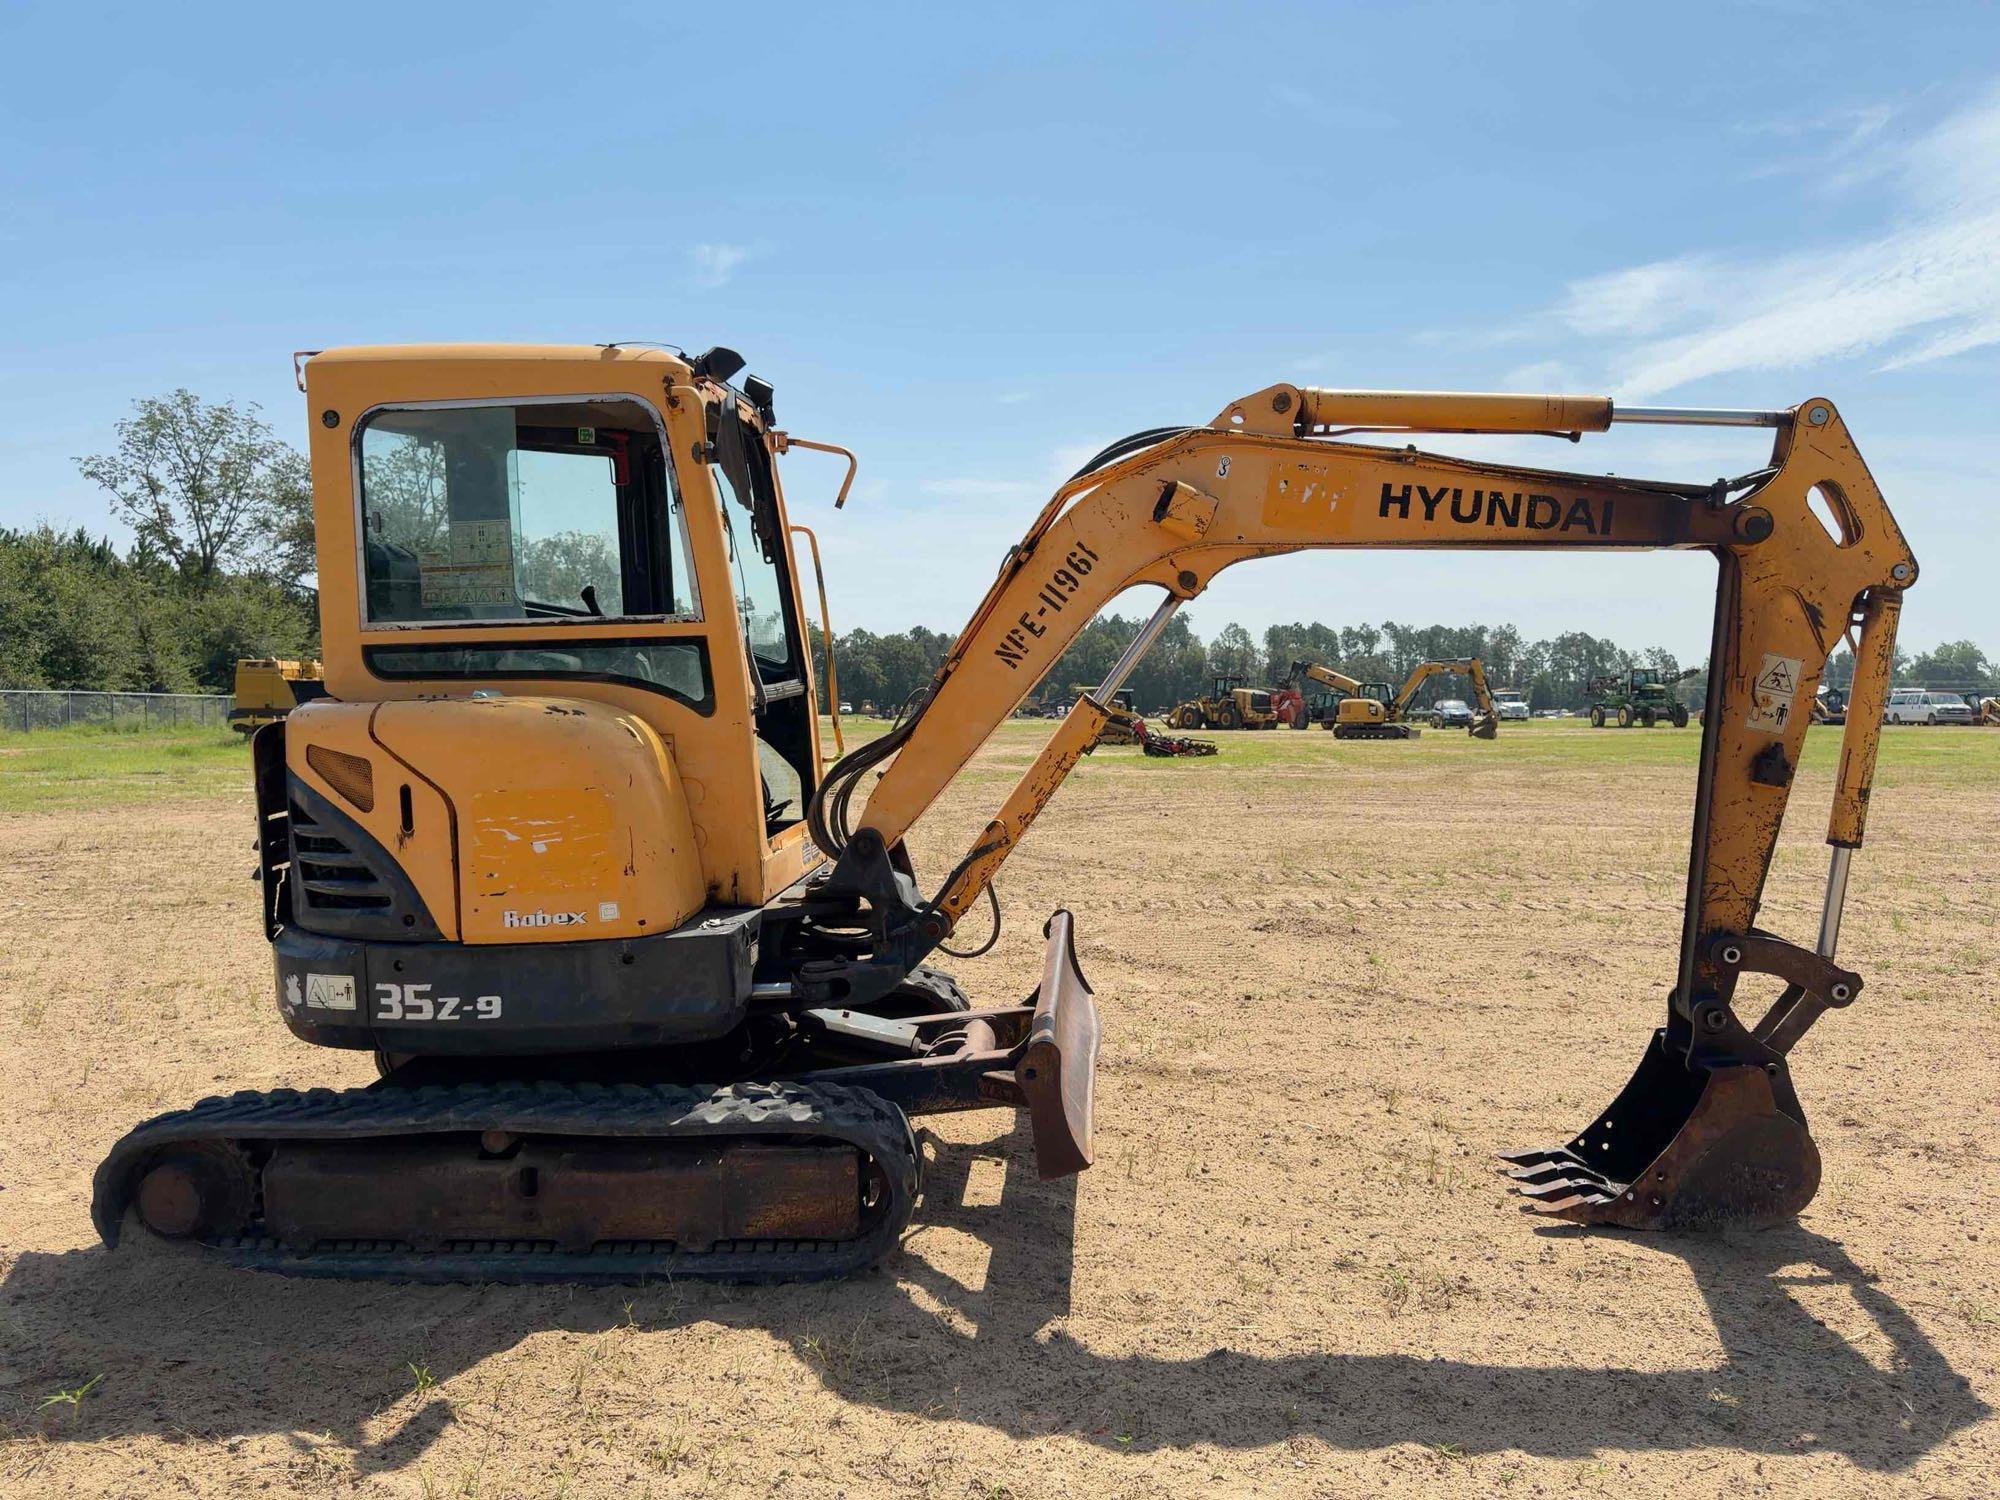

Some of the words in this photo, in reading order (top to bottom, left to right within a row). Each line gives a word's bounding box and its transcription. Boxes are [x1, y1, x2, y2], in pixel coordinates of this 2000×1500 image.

[1379, 483, 1614, 535] HYUNDAI
[994, 541, 1099, 670] NPE-11961
[375, 983, 502, 1020] 35Z-9
